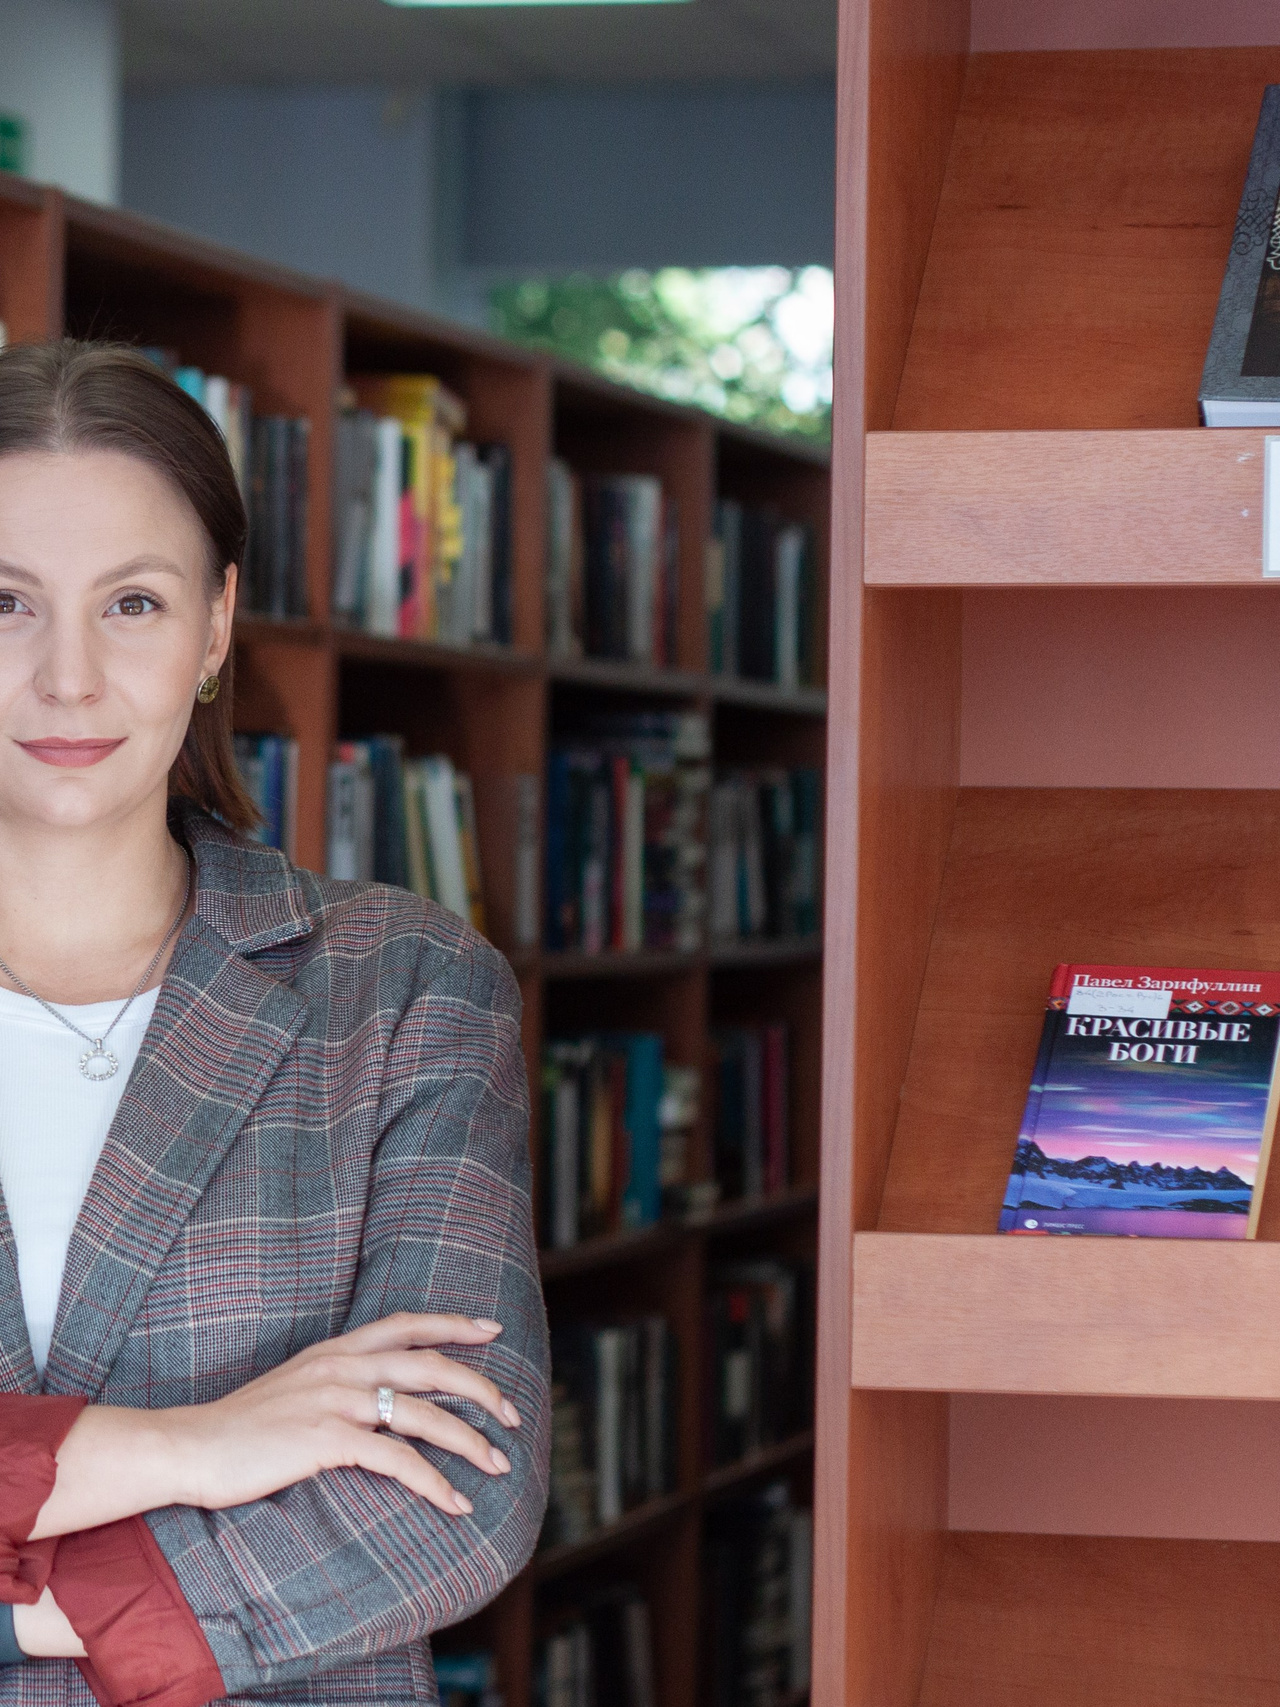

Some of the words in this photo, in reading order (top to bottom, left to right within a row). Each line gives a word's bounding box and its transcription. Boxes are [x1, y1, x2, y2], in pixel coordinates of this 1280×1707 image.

[1073, 974, 1133, 988] Павел
[1137, 976, 1261, 994] Зарифуллин
[1065, 1016, 1251, 1042] КРАСИВЫЕ
[1108, 1042, 1200, 1064] БОГИ
